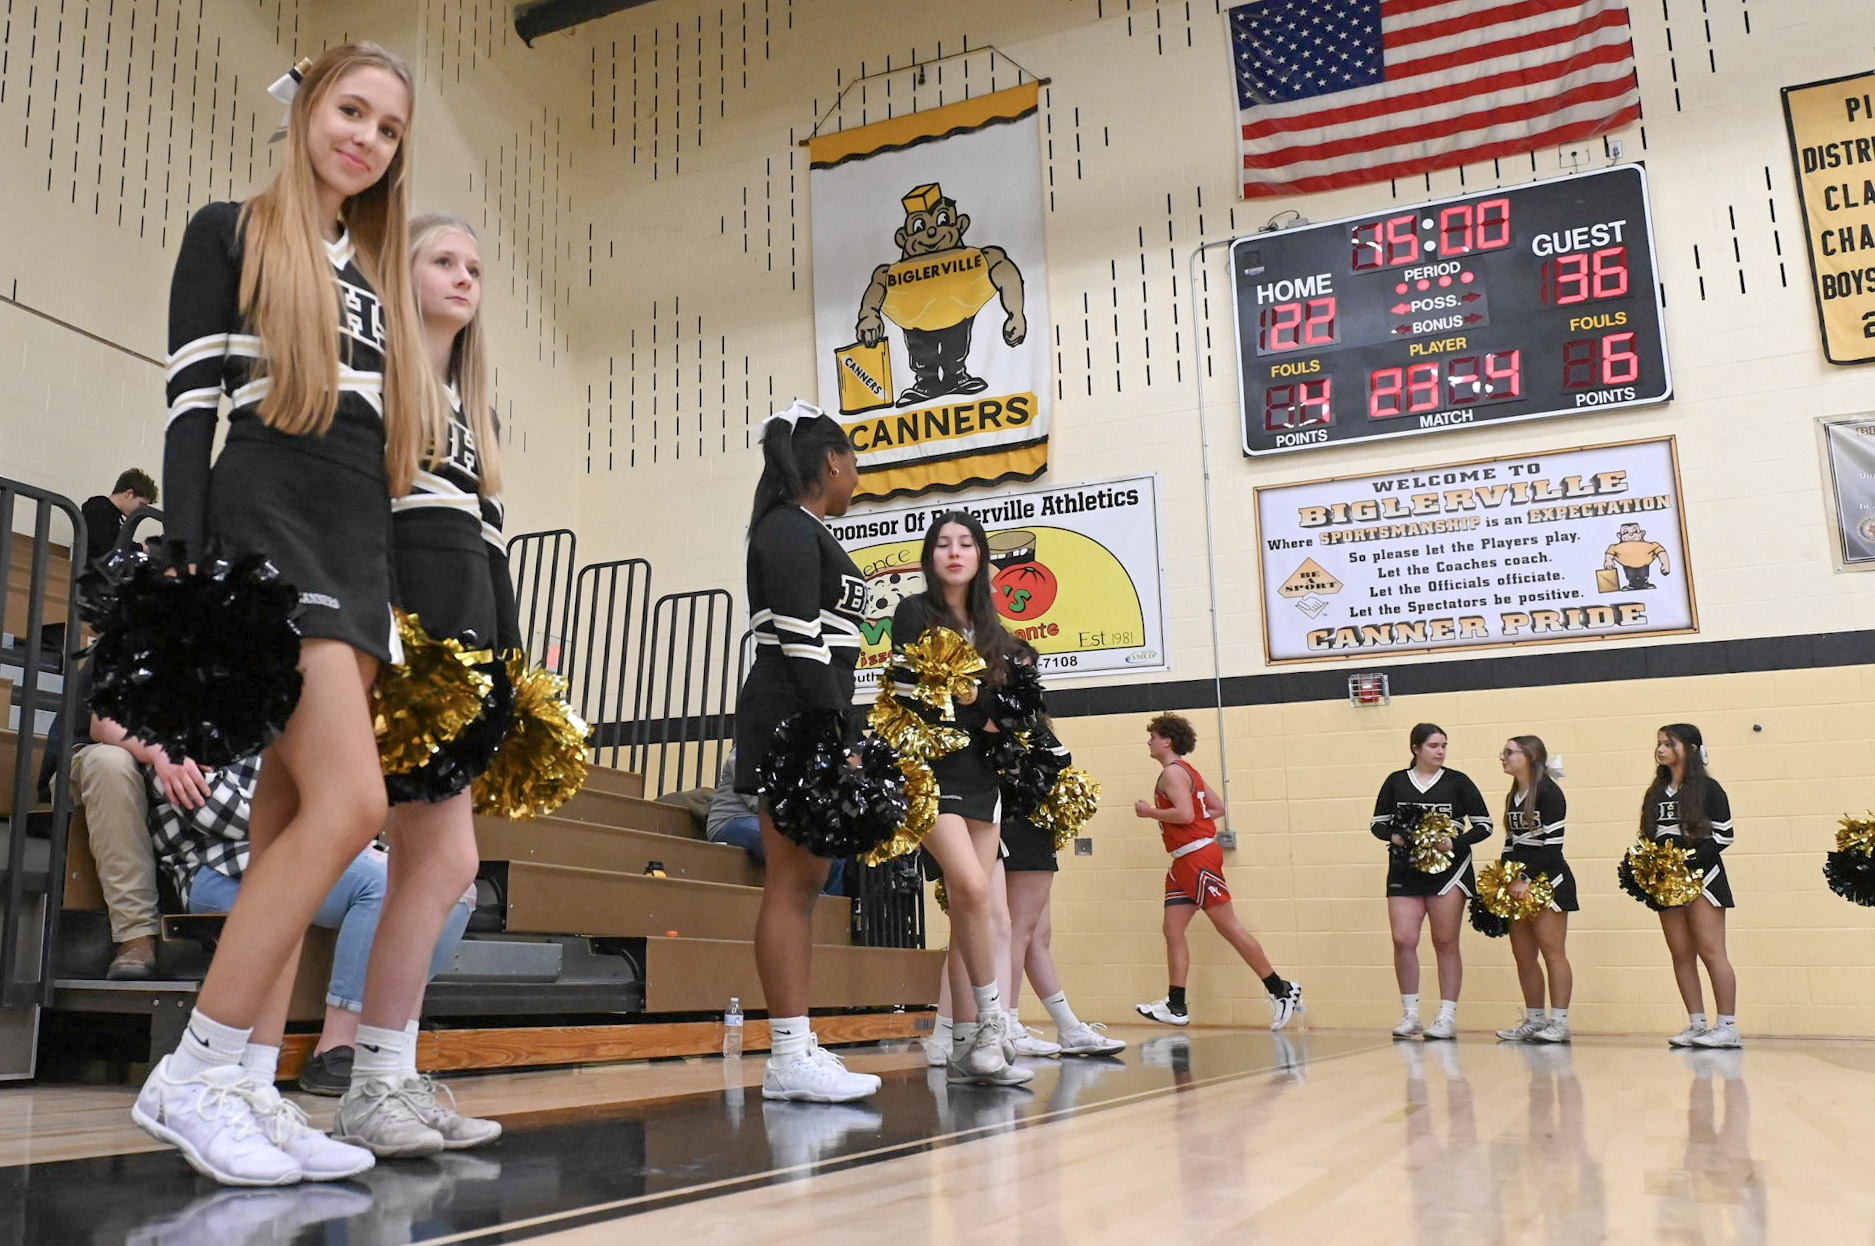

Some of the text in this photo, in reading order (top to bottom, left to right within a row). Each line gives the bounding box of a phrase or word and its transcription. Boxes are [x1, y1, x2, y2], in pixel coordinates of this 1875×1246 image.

[1532, 220, 1626, 257] GUEST
[887, 254, 982, 287] BIGLERVILLE
[1404, 261, 1461, 282] PERIOD
[1556, 246, 1628, 304] 36
[1257, 273, 1333, 305] HOME
[1411, 295, 1461, 312] POSS.
[1270, 297, 1336, 350] 22
[1412, 315, 1463, 334] BONUS
[1570, 311, 1627, 332] FOULS
[1409, 337, 1467, 357] PLAYER
[844, 357, 882, 395] CANNERS
[1271, 360, 1320, 378] FOULS
[1576, 387, 1636, 407] POINTS
[850, 396, 1029, 452] CANNERS
[1420, 409, 1474, 428] MATCH
[1276, 429, 1328, 447] POINTS
[1372, 463, 1541, 493] WELCOME TO
[1299, 470, 1629, 528] BIGLERVILLE
[825, 487, 1139, 542] ponsor Of erville Athletics
[1268, 494, 1671, 551] Where SPORTSMANSHIP is an EXPECTATION
[1349, 531, 1581, 564] So please let the Players play.
[1377, 552, 1552, 579] Let the Coaches coach.
[1369, 570, 1565, 598] Let the Officials officiate.
[1350, 588, 1584, 618] Let the Spectators be positive.
[1079, 631, 1134, 648] Est 1981
[1307, 602, 1648, 651] CANNER PRIDE
